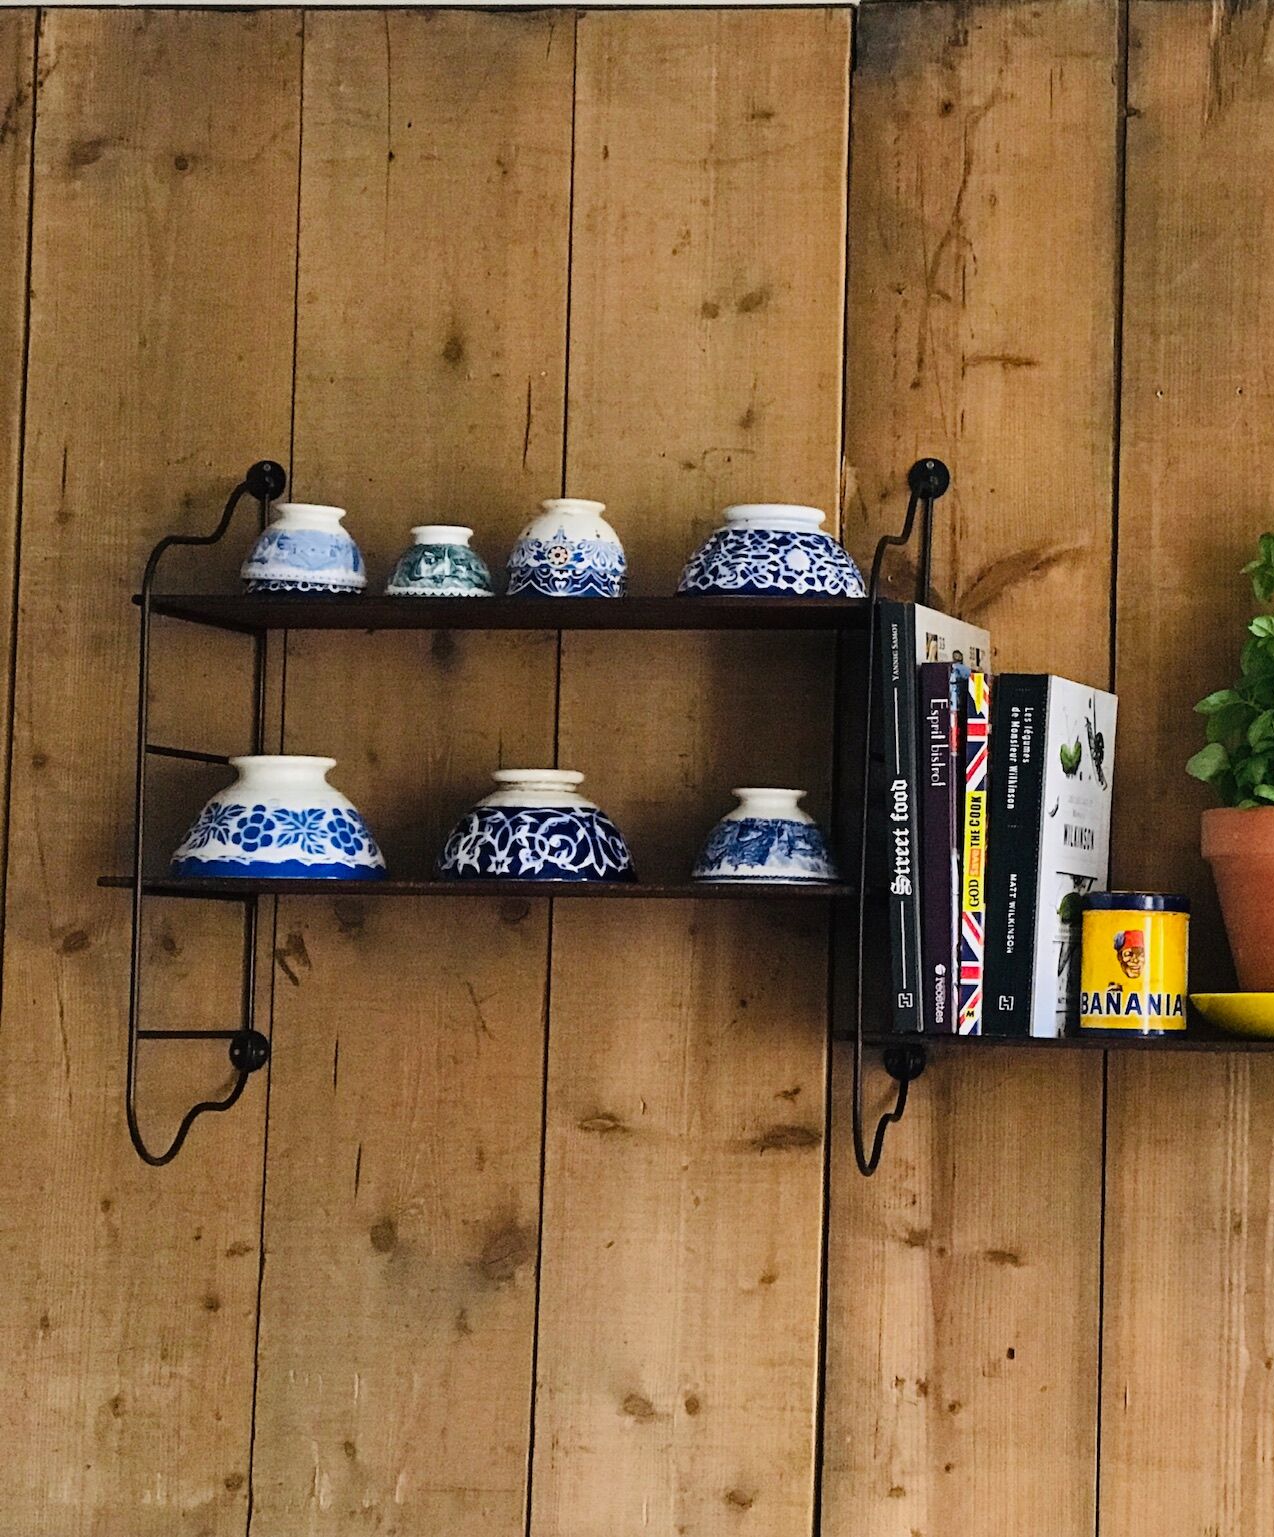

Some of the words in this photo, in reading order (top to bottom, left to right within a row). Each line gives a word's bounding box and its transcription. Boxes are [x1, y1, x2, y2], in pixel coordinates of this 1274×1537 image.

[926, 698, 949, 740] Esprit
[1011, 706, 1022, 718] de
[1024, 706, 1035, 723] Les
[1008, 720, 1021, 763] Monsieur
[1021, 725, 1035, 764] légumes
[931, 743, 949, 787] bistrot
[890, 779, 909, 823] food
[1006, 764, 1019, 810] Wilkinson
[969, 796, 982, 827] COOK
[971, 829, 980, 847] THE
[890, 827, 912, 896] Street
[968, 879, 980, 907] GOD
[1009, 873, 1018, 899] MATT
[1006, 901, 1018, 954] WILKINSON
